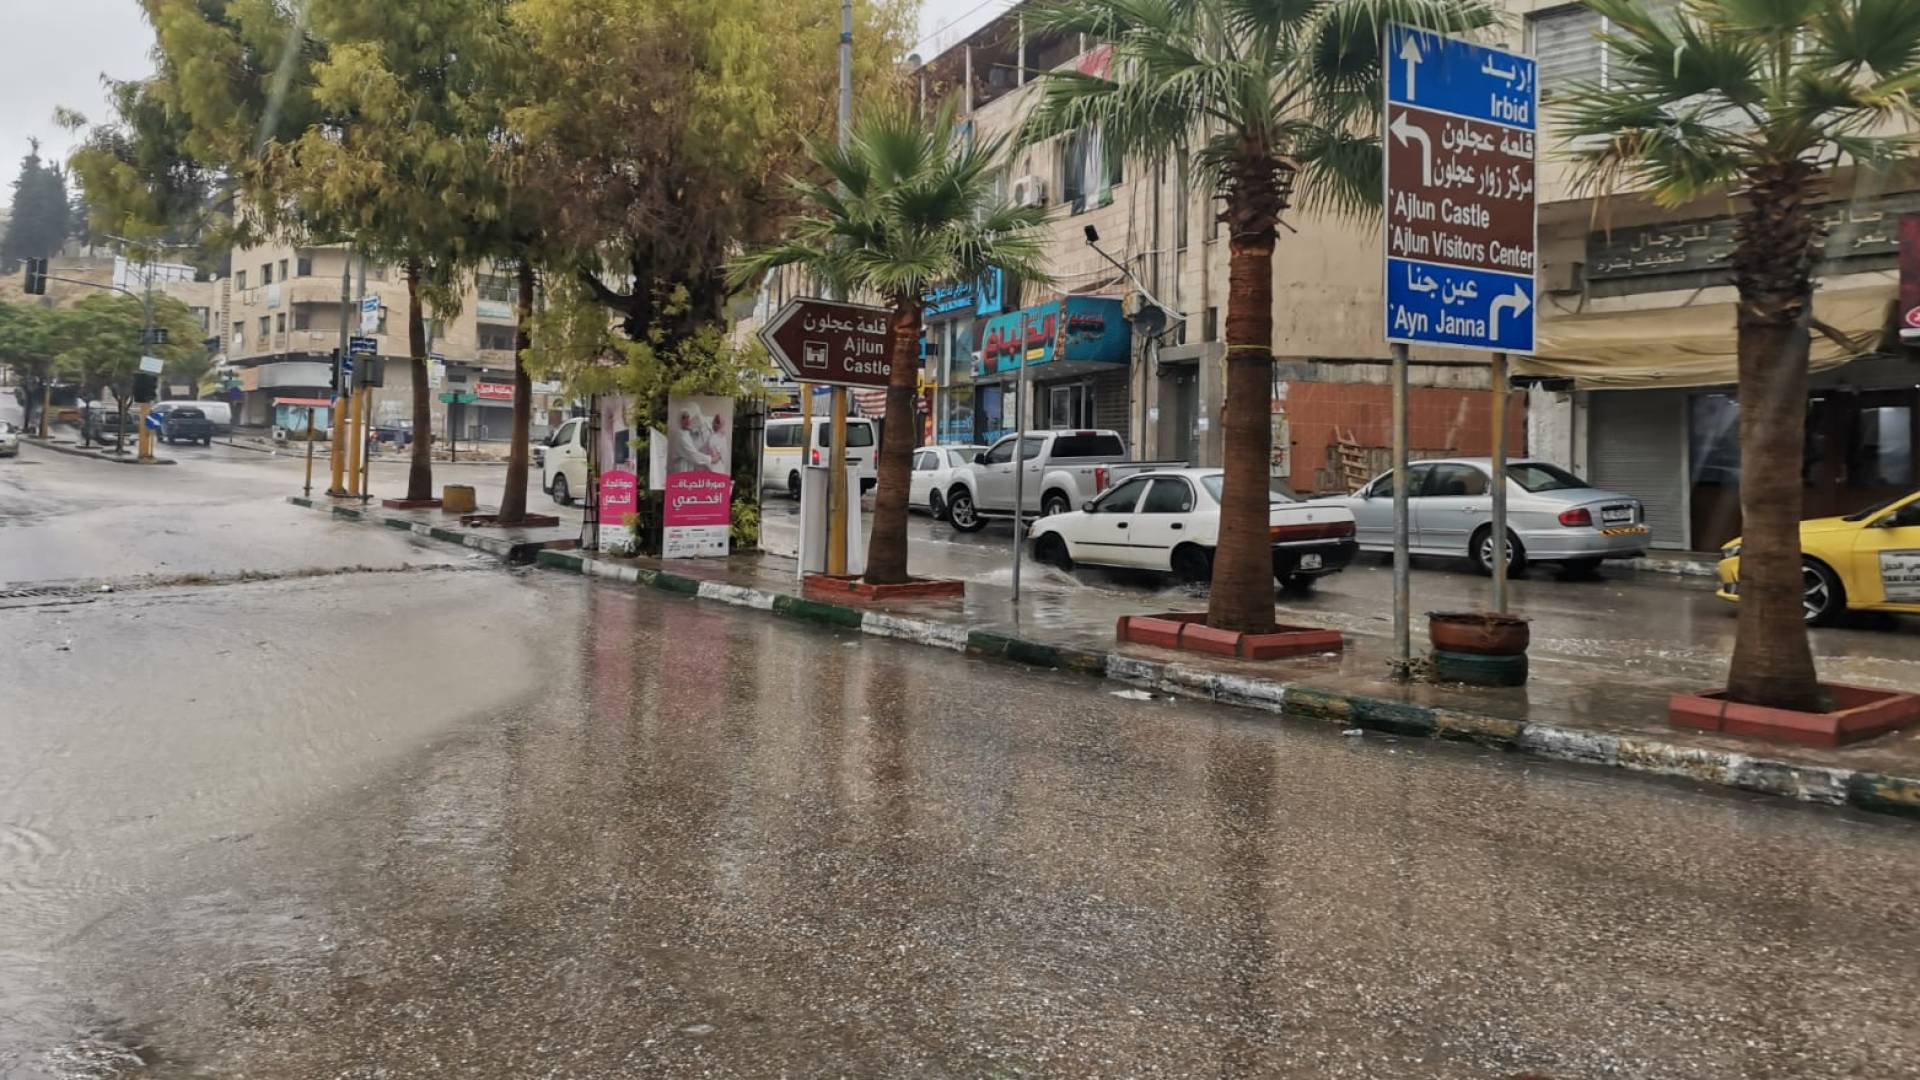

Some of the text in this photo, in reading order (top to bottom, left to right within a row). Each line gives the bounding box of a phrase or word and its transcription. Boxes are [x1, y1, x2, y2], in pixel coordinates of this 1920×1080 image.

[1481, 54, 1532, 93] إربد
[1491, 92, 1528, 123] Irbid
[1442, 119, 1533, 159] قلعة عجلون
[1434, 153, 1533, 200] مركز زوار عجلون
[1441, 198, 1490, 229] Castle
[1432, 230, 1485, 263] Visitors
[1489, 240, 1534, 270] Center
[1408, 263, 1478, 304] عين جنا
[803, 312, 887, 335] قلعة عجلون
[1435, 308, 1485, 338] Janna
[844, 336, 884, 357] Ajlun
[843, 356, 891, 376] Castle
[706, 480, 726, 490] صورة
